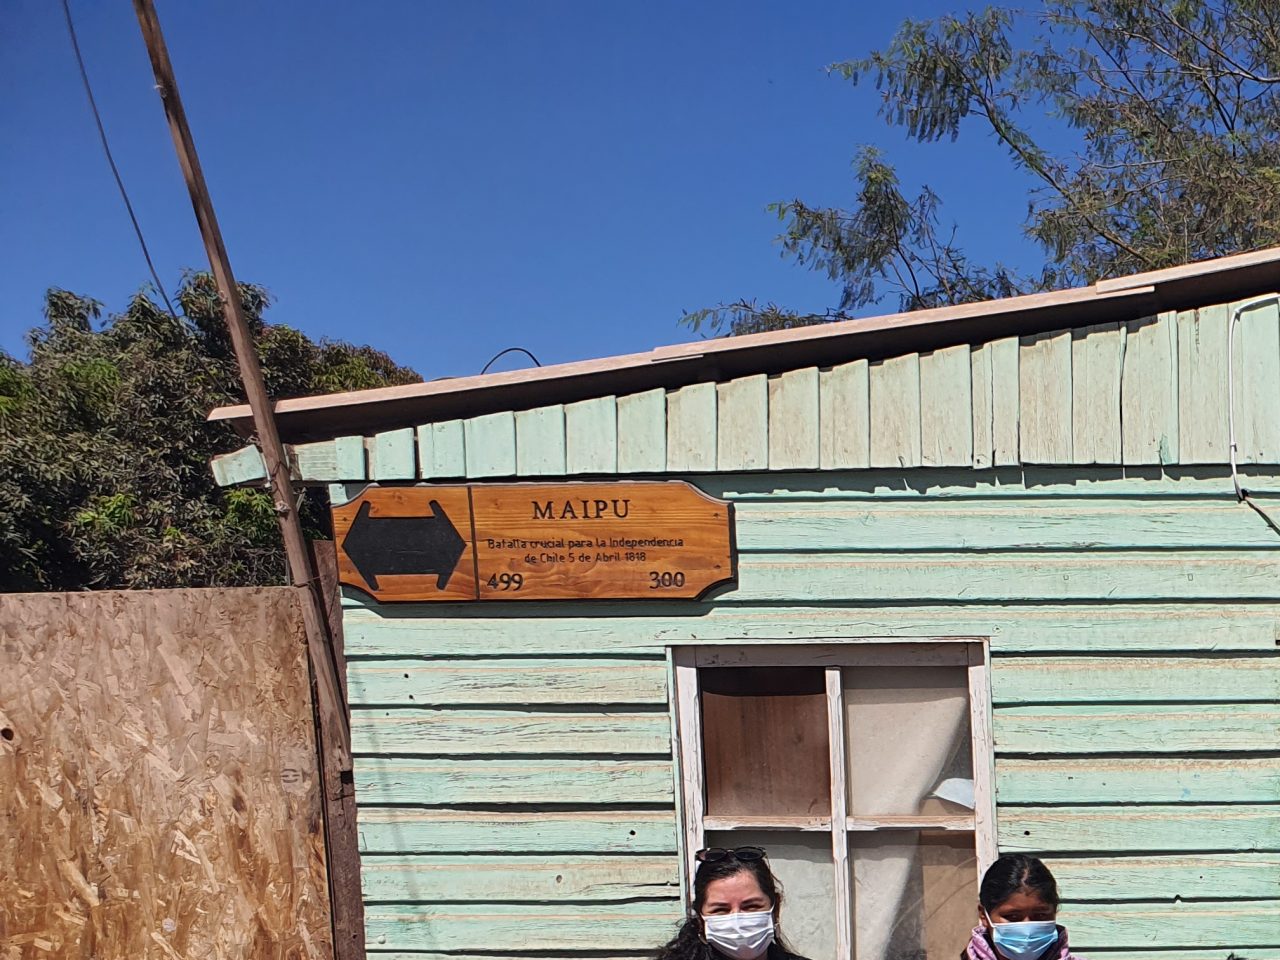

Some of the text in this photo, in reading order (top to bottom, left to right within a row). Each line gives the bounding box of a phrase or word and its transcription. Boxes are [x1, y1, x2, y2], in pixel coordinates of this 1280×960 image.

[531, 499, 630, 519] MAIPU
[488, 537, 683, 550] Batalla crucial para la Independencia
[524, 552, 646, 563] de Chile 5 de Abril 1818
[487, 571, 686, 591] 499 300
